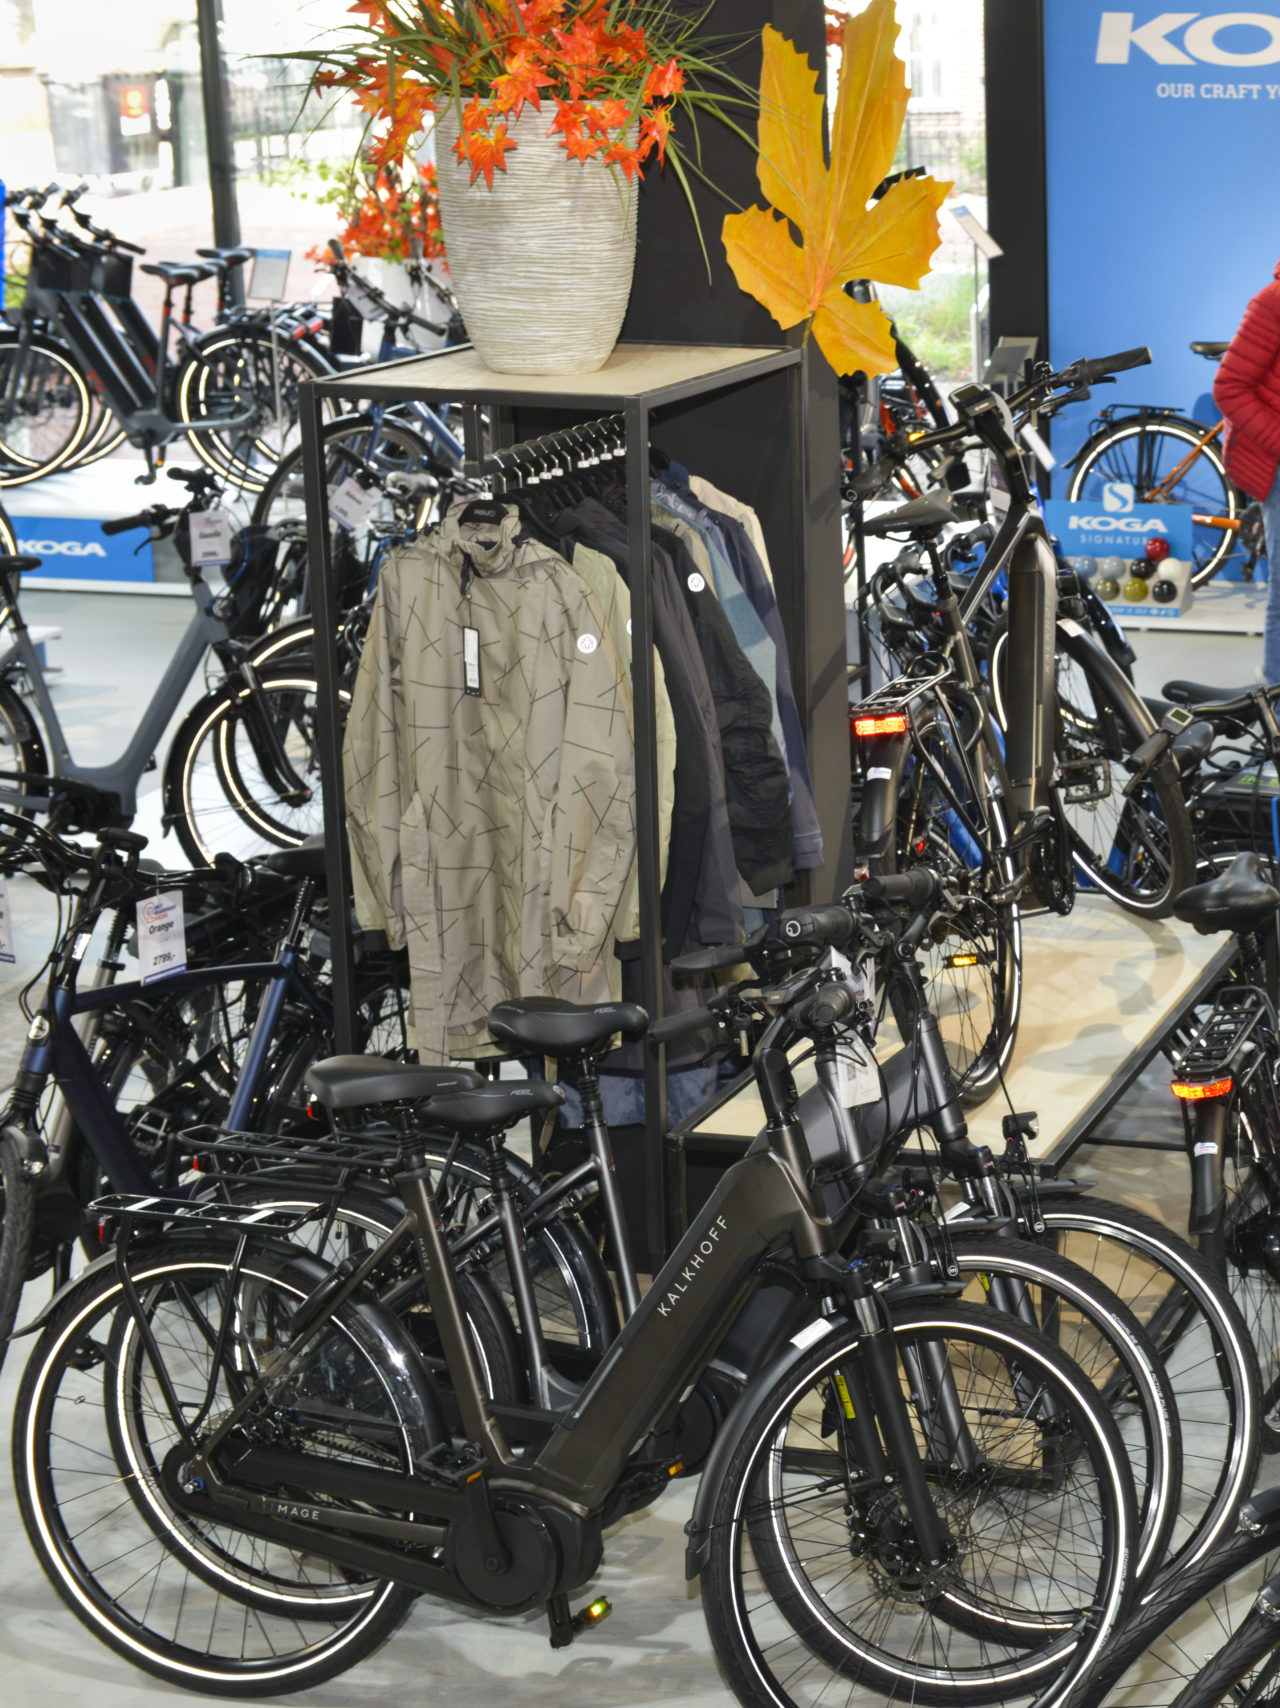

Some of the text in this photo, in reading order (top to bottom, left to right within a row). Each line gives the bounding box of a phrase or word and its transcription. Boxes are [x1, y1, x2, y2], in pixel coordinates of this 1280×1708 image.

[1156, 83, 1196, 98] OUR
[1200, 83, 1262, 99] CRAFT
[1068, 515, 1168, 533] KOGA
[1080, 534, 1149, 545] SIGNATUR
[17, 540, 107, 557] KOGA
[149, 921, 174, 935] Orange
[657, 1215, 727, 1317] KALKHOFF
